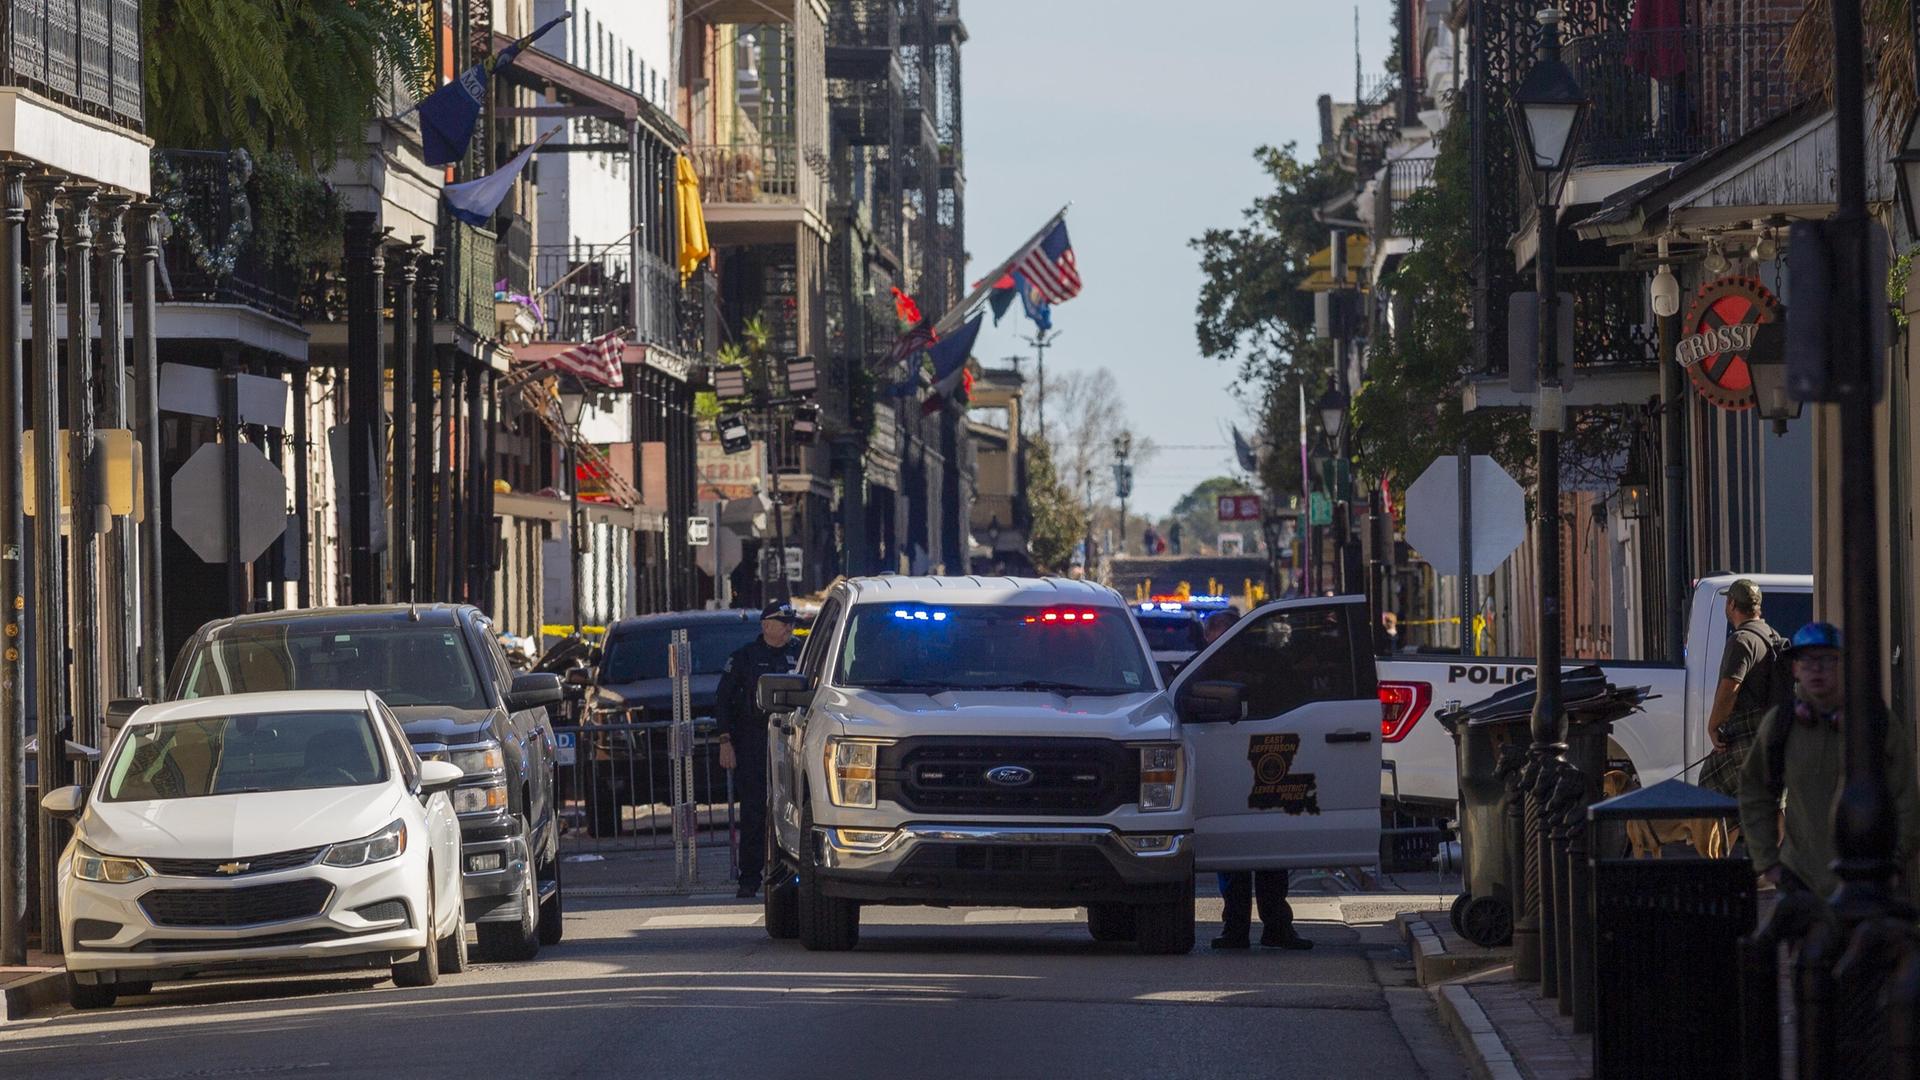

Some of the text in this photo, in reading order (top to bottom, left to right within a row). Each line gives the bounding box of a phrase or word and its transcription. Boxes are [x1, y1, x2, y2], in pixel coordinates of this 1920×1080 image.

[697, 463, 752, 480] ERIA
[1448, 665, 1537, 684] POLIC
[1263, 735, 1285, 744] EAST
[1251, 743, 1296, 753] JEFFERSON
[1276, 783, 1308, 793] DISTRICT
[1280, 792, 1305, 800] POLICE
